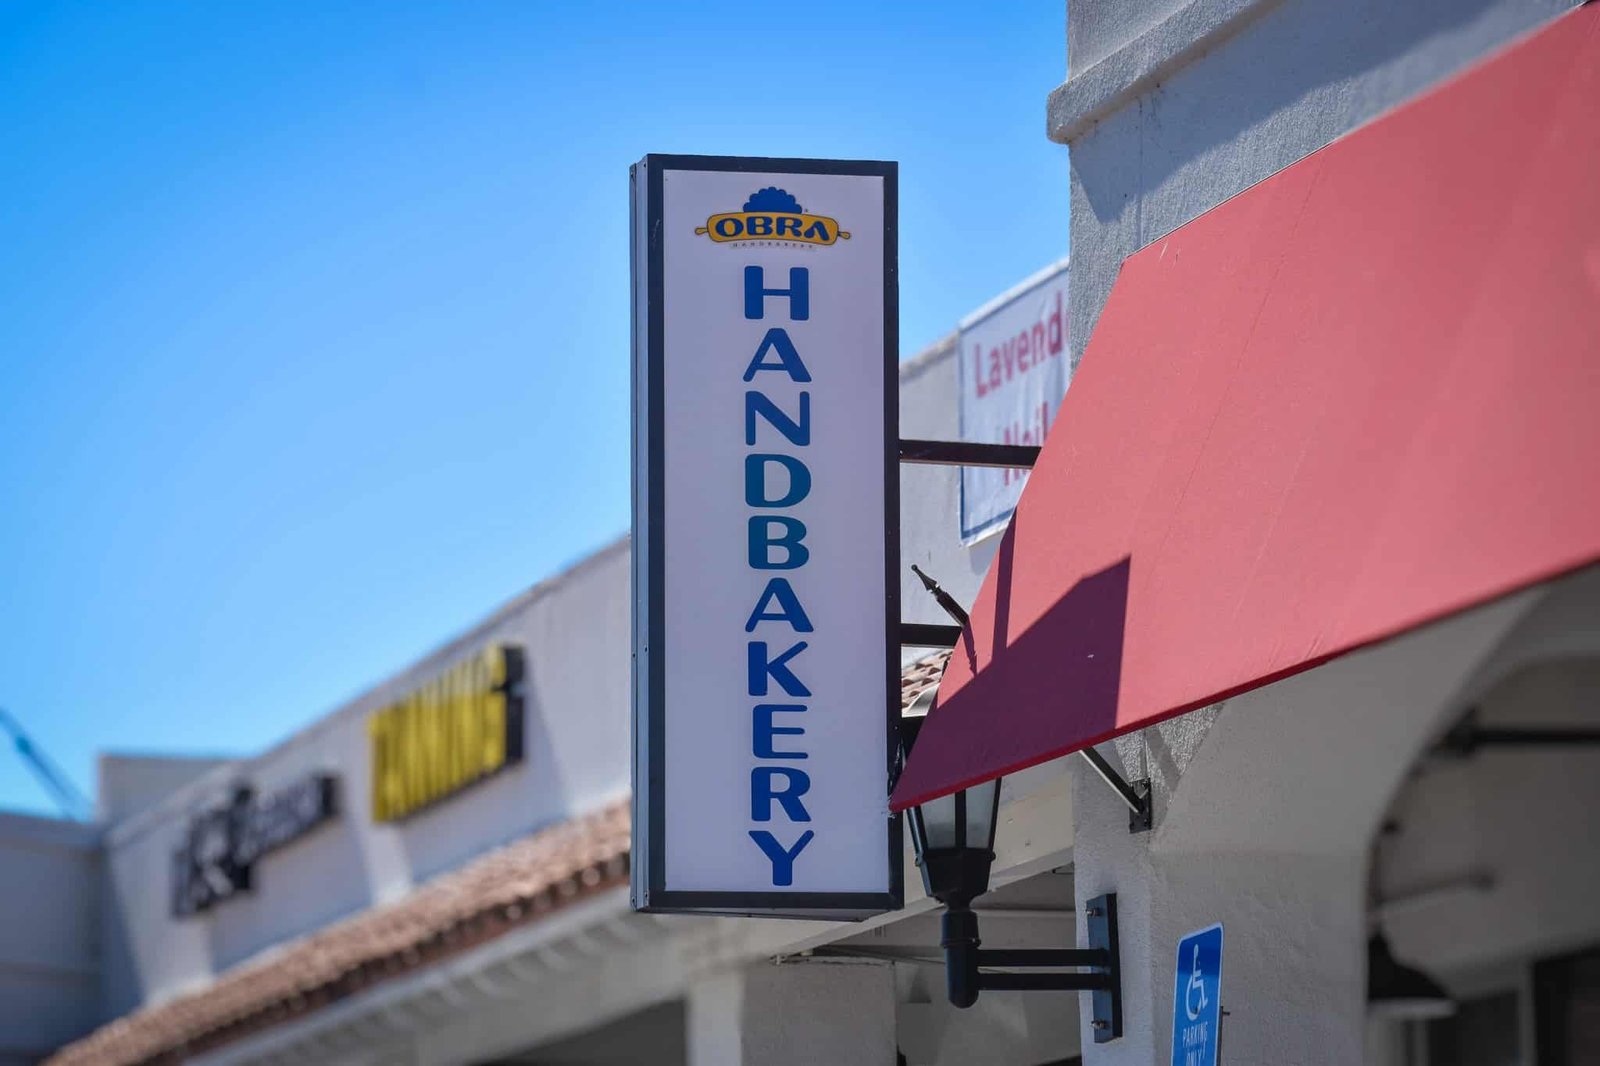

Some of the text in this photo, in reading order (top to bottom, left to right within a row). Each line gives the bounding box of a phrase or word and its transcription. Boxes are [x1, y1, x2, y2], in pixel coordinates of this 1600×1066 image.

[715, 216, 830, 241] OBRA
[973, 290, 1068, 399] Lavend
[742, 265, 815, 887] HANDBAKERY
[1182, 1021, 1208, 1048] PARKING
